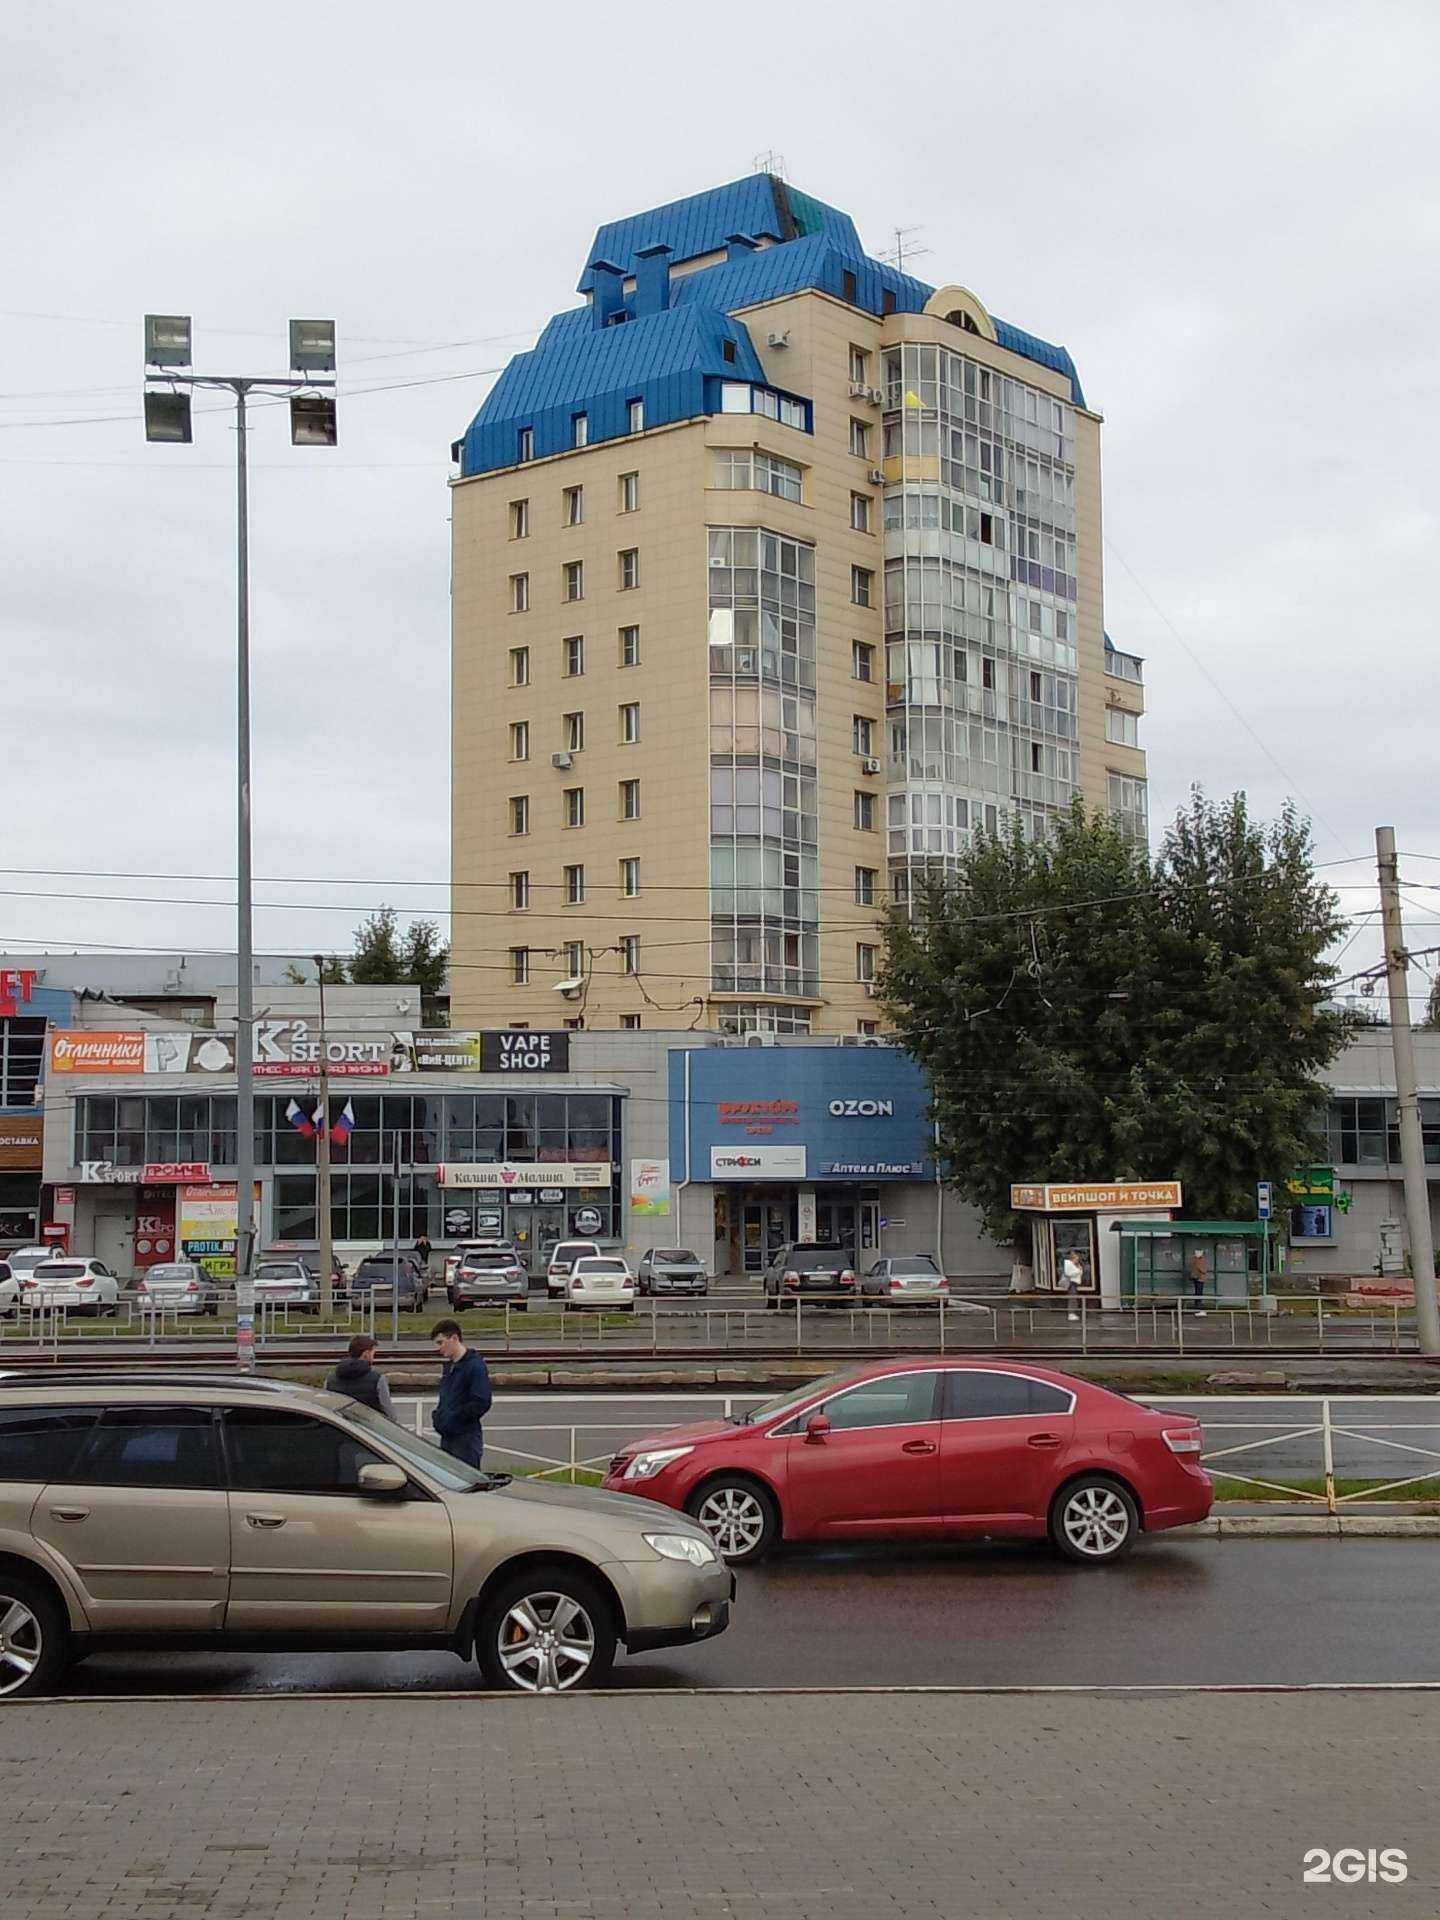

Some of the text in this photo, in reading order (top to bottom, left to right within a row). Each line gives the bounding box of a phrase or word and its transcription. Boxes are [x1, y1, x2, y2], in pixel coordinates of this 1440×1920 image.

[500, 1035, 550, 1050] VAPE
[500, 1053, 550, 1069] SHOP
[829, 1100, 893, 1116] OZON
[0, 1136, 39, 1146] ОСТАВКА
[1053, 1191, 1116, 1204] ВЕЙПШОП
[1131, 1190, 1173, 1201] ТОЧКА
